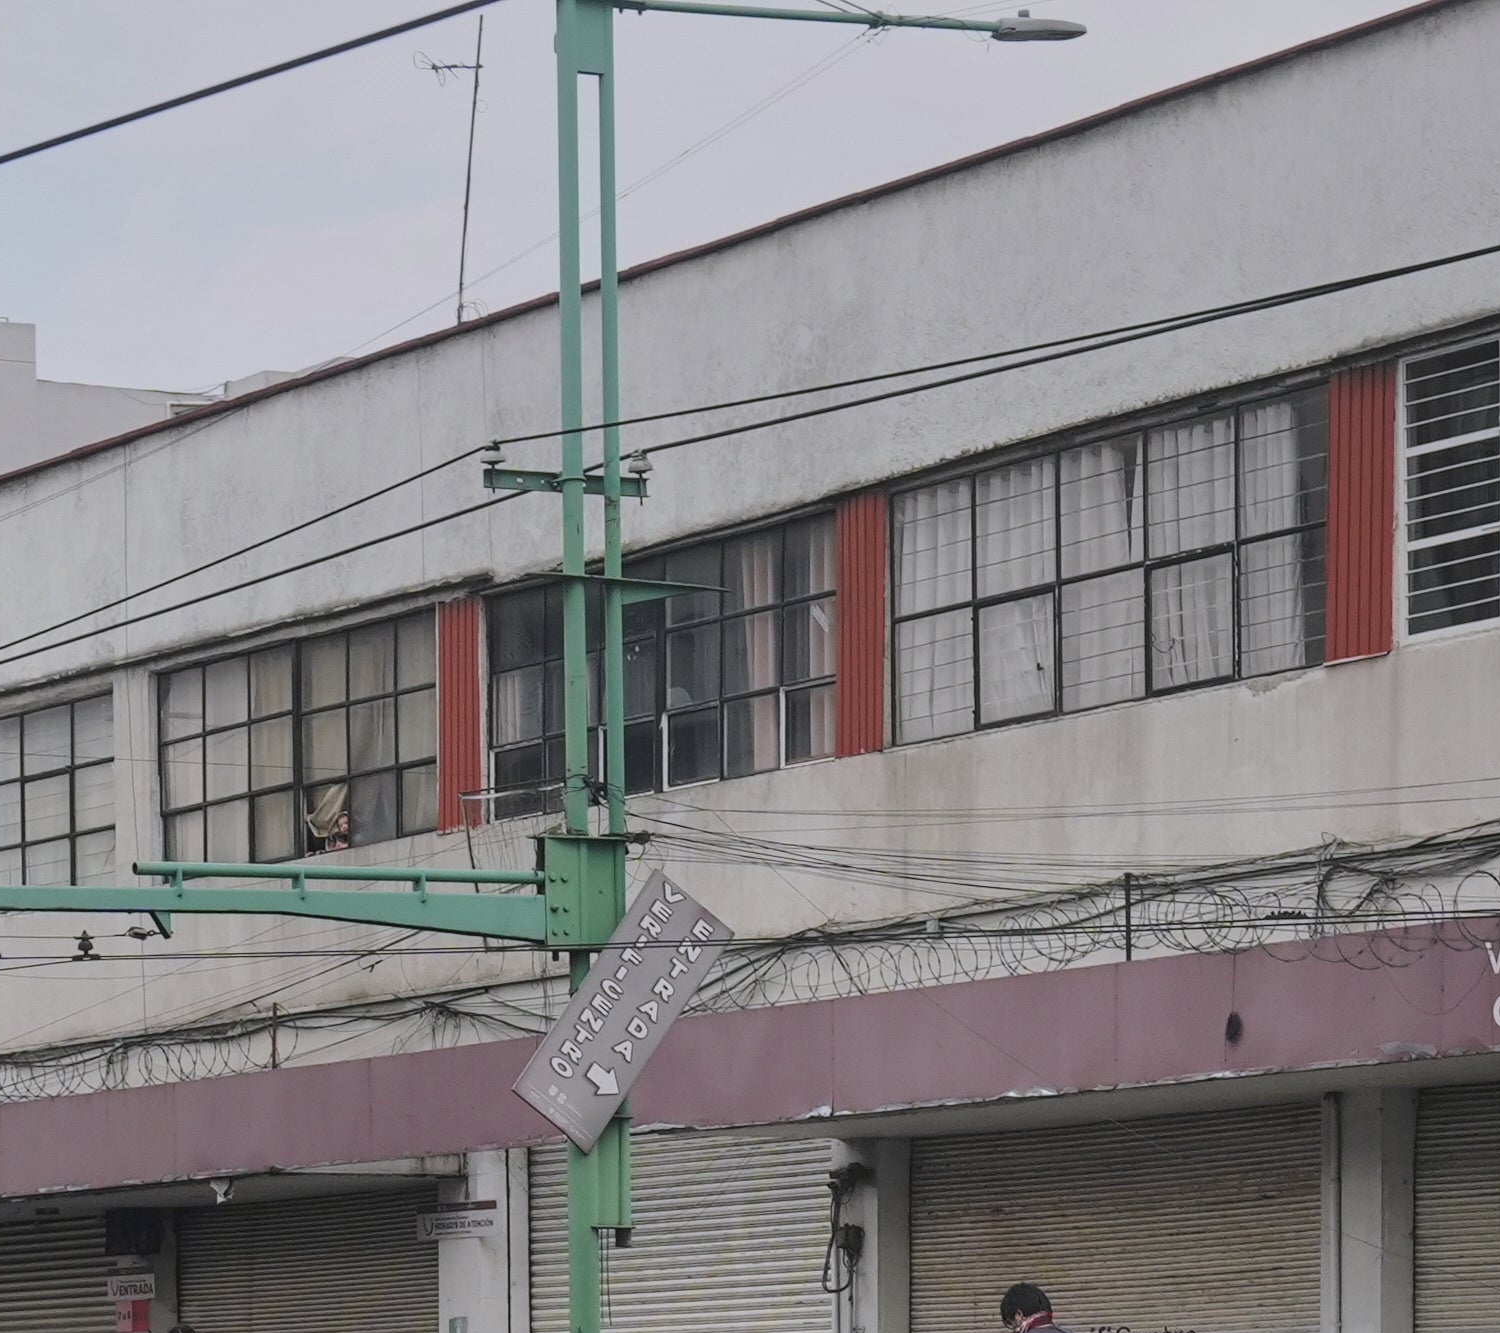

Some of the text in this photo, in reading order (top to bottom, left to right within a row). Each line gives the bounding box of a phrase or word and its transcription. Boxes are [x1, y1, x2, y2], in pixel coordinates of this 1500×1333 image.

[550, 881, 687, 1079] VERIFICENTRO
[612, 918, 715, 1063] ENTRADA
[120, 1283, 153, 1296] ENTRADA
